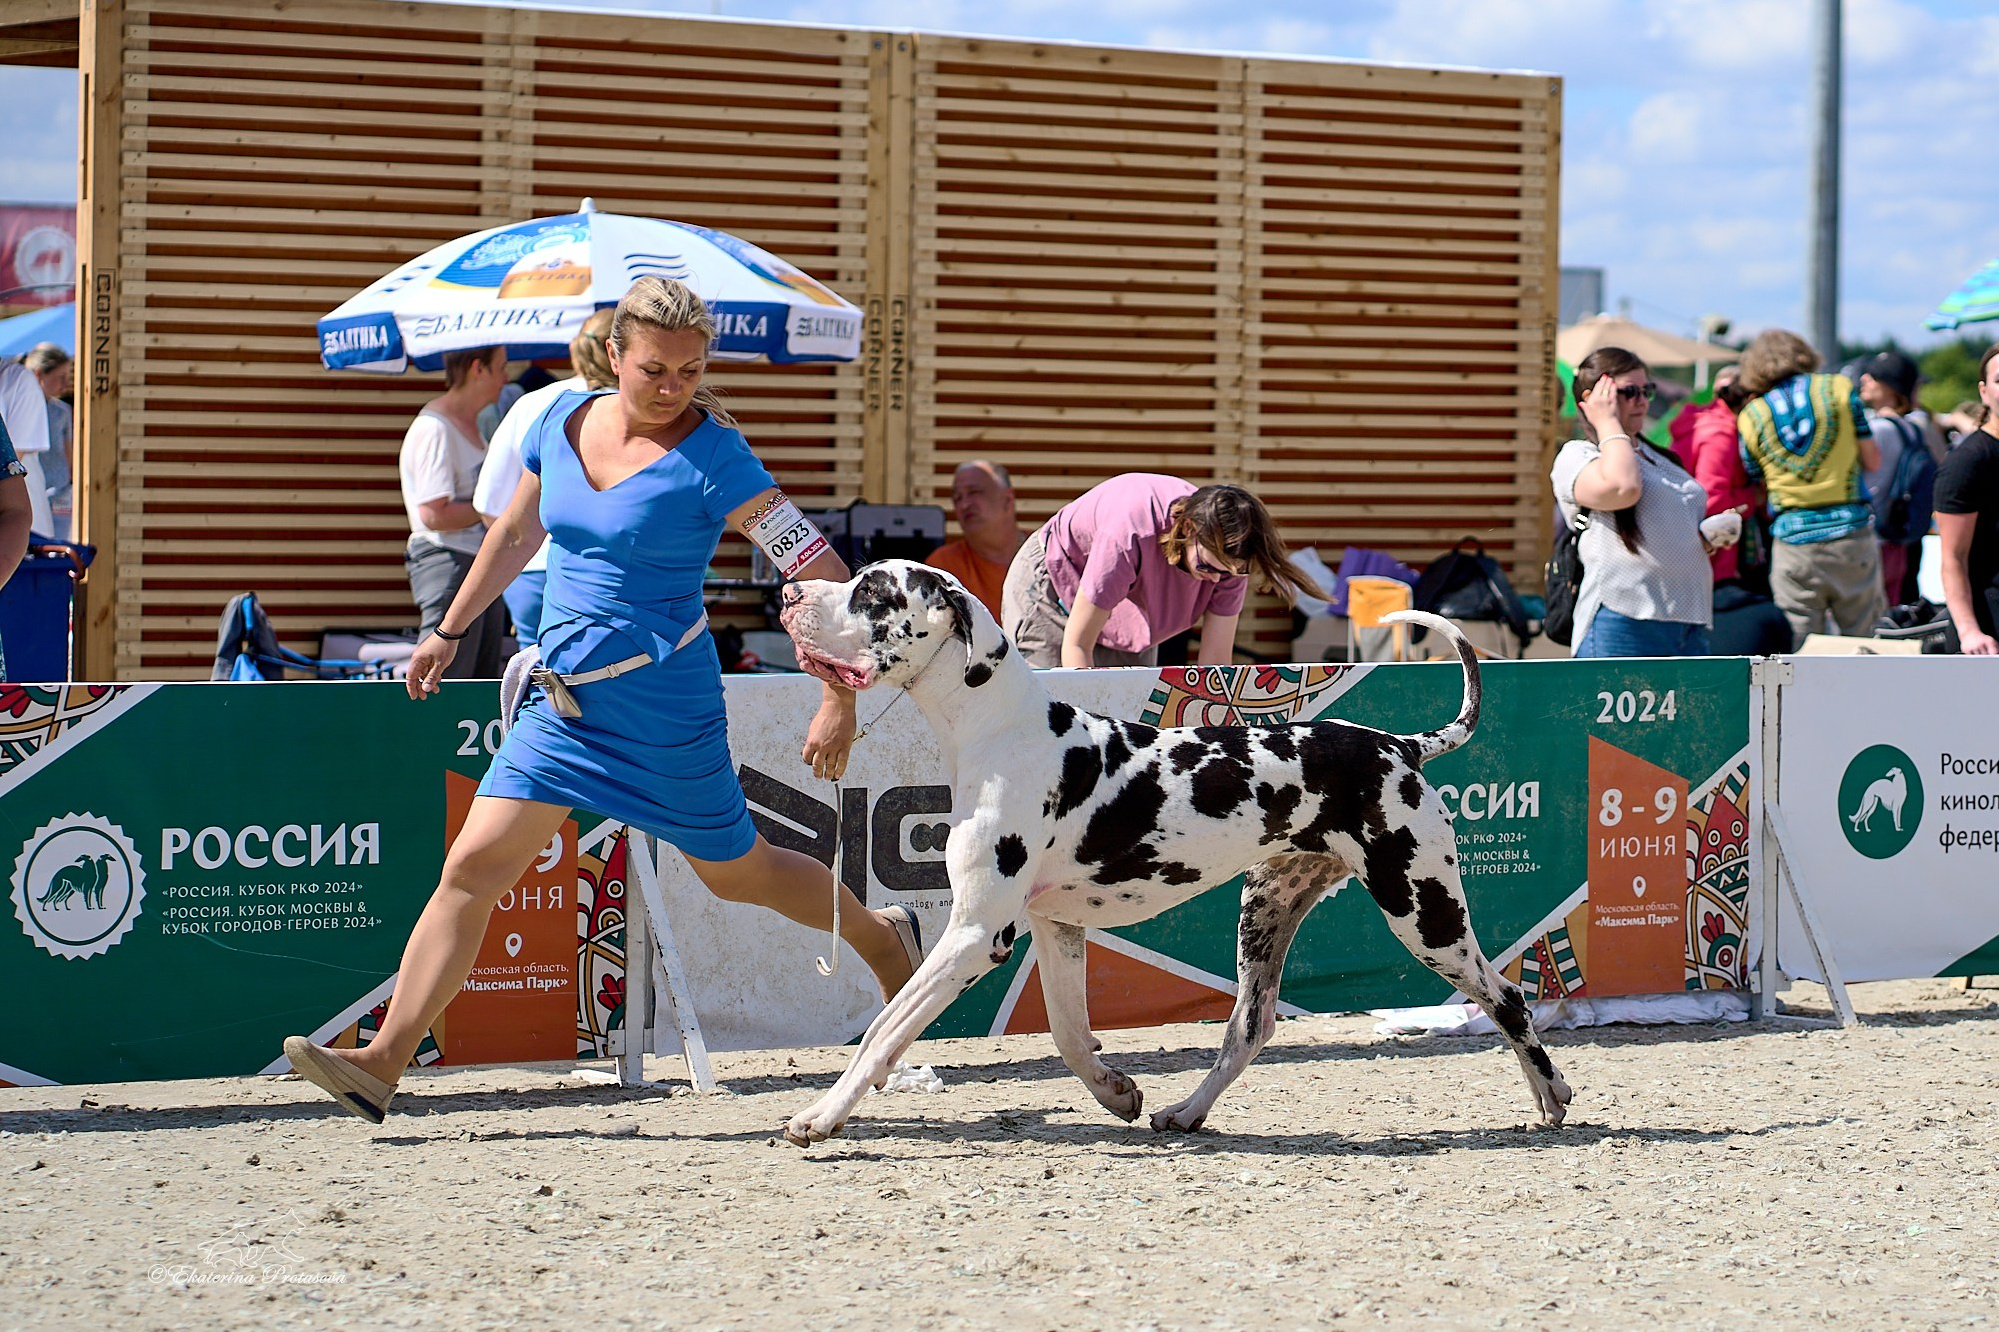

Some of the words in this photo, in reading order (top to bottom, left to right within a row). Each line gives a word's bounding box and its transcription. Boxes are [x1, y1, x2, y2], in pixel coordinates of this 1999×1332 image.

[95, 272, 112, 396] CORNER
[432, 309, 566, 335] БАЛТИКА
[329, 325, 389, 352] БАЛТИКА
[867, 299, 884, 413] CORNER
[889, 299, 907, 414] CORNER
[771, 522, 810, 558] 0823
[1596, 689, 1677, 723] 2024
[456, 719, 503, 756] 20
[1436, 781, 1540, 821] ССИЯ
[1599, 788, 1623, 827] 8
[1654, 786, 1678, 825] 9
[161, 822, 380, 870] РОССИЯ
[1473, 834, 1495, 844] РКФ
[1497, 832, 1527, 843] 2024»
[1473, 849, 1520, 861] МОСКВЫ
[1522, 849, 1530, 860] &
[1460, 864, 1510, 876] В-ГЕРОЕВ
[1512, 862, 1541, 873] 2024»
[162, 885, 234, 898] «РОССИЯ.
[239, 883, 286, 896] КУБОК
[291, 882, 320, 895] РКФ
[324, 881, 363, 894] 2024»
[162, 905, 234, 919] «РОССИЯ.
[239, 904, 286, 917] КУБОК
[290, 902, 353, 915] МОСКВЫ
[357, 901, 367, 913] &
[1595, 904, 1644, 914] Московская
[1595, 916, 1646, 927] «Максима
[1647, 913, 1679, 927] Парк»
[162, 922, 210, 935] КУБОК
[214, 918, 339, 934] ГОРОДОВ-ГЕРОЕВ
[343, 916, 383, 929] 2024»
[471, 965, 520, 976] сковская
[523, 962, 569, 973] область,
[461, 979, 523, 991] Максима
[526, 976, 568, 992] Парк»
